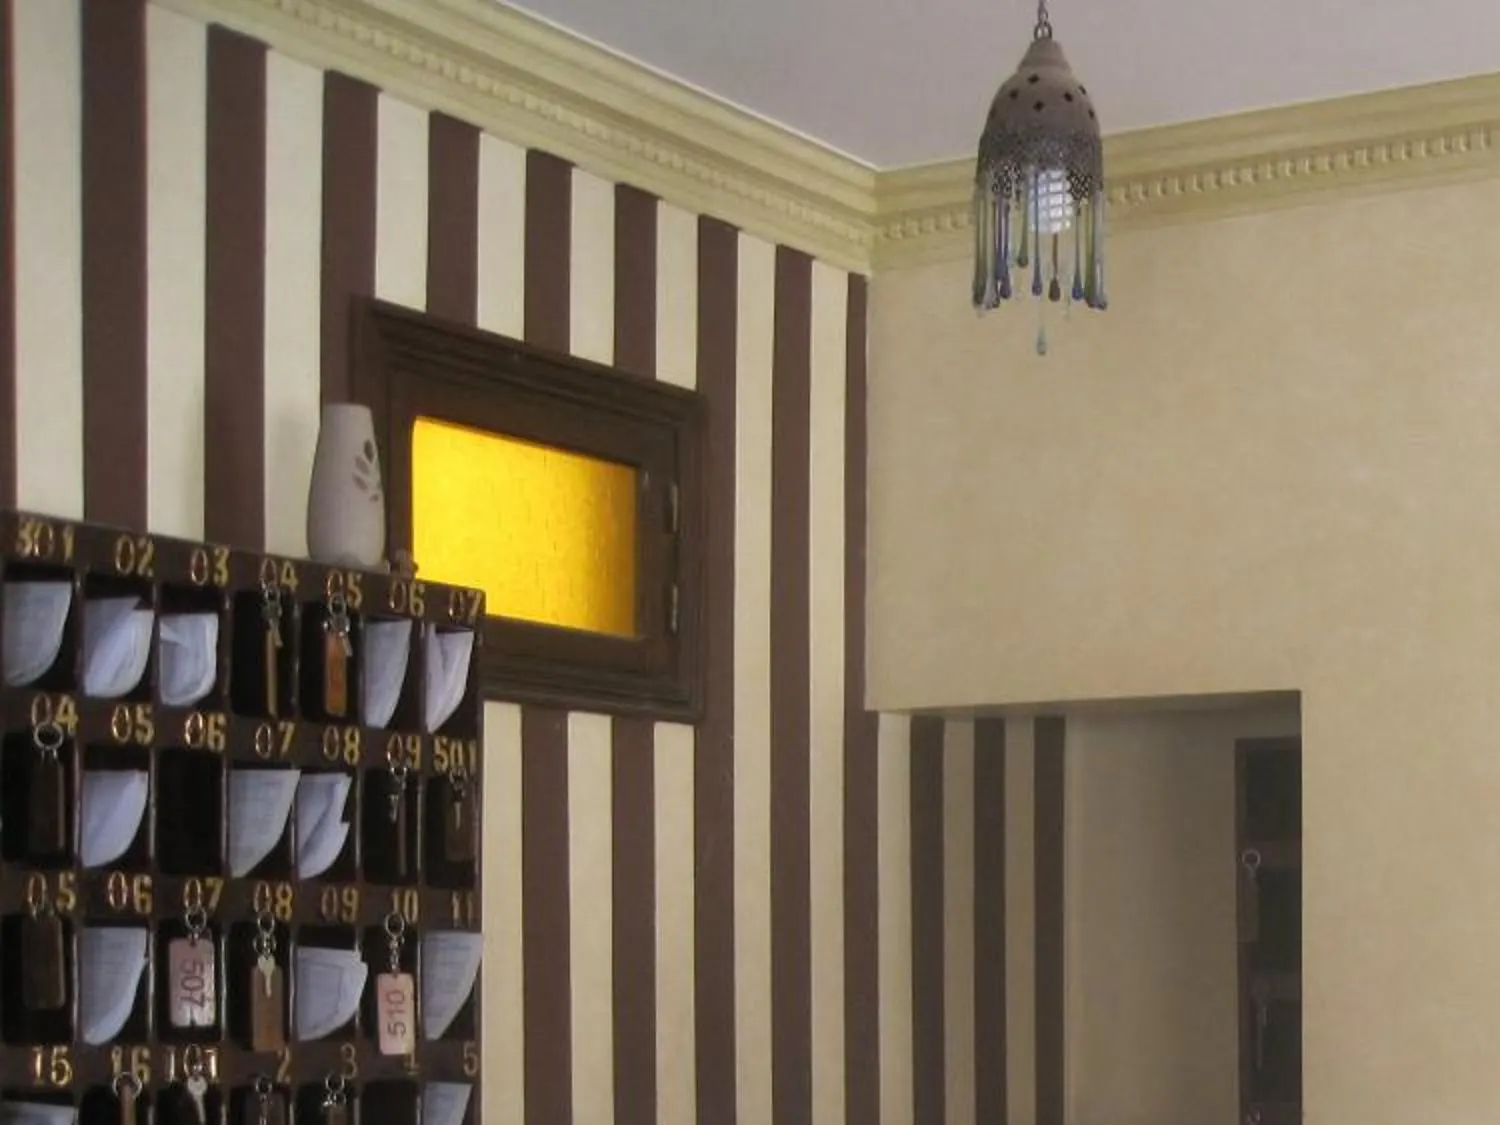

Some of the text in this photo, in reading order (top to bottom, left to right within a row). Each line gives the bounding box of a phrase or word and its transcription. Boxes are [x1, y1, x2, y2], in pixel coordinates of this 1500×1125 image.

[114, 533, 155, 576] 02
[190, 547, 230, 587] 03
[260, 558, 299, 592] 04
[326, 569, 363, 609] 05
[389, 577, 426, 618] 06
[449, 590, 482, 625] 07
[31, 693, 79, 737] 04
[111, 704, 155, 745] 05
[184, 711, 227, 751] 06
[255, 721, 295, 760] 07
[323, 724, 360, 766] 08
[387, 732, 421, 770] 09
[27, 871, 77, 912] 05
[108, 871, 153, 914] 06
[183, 876, 224, 913] 07
[254, 880, 293, 922] 08
[321, 884, 360, 922] 09
[31, 1045, 73, 1087] 15
[111, 1046, 151, 1084] 16
